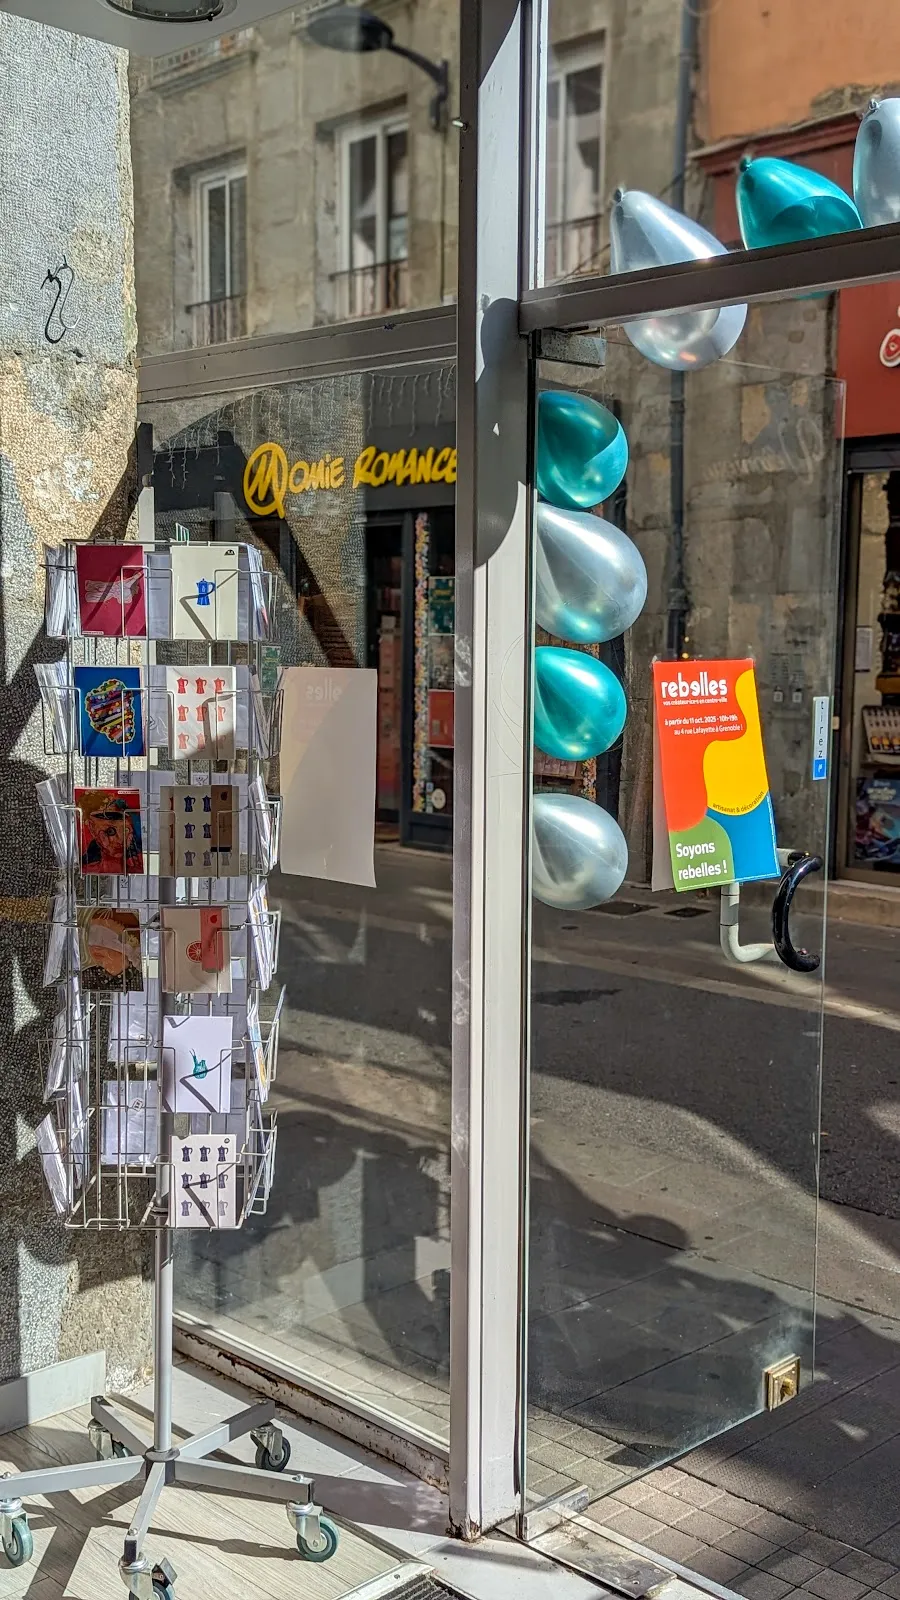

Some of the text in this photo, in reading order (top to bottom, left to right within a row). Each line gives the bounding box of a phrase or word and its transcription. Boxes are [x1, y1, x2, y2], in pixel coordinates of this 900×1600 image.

[661, 671, 728, 698] rebelles
[664, 718, 669, 726] à
[669, 717, 683, 726] partir
[689, 716, 695, 724] 11
[704, 715, 717, 723] 2025
[693, 726, 716, 735] Lafayette
[719, 724, 740, 732] Grenoble
[712, 803, 735, 813] artisanat
[675, 842, 716, 860] Soyons
[678, 859, 728, 881] rebelles !
